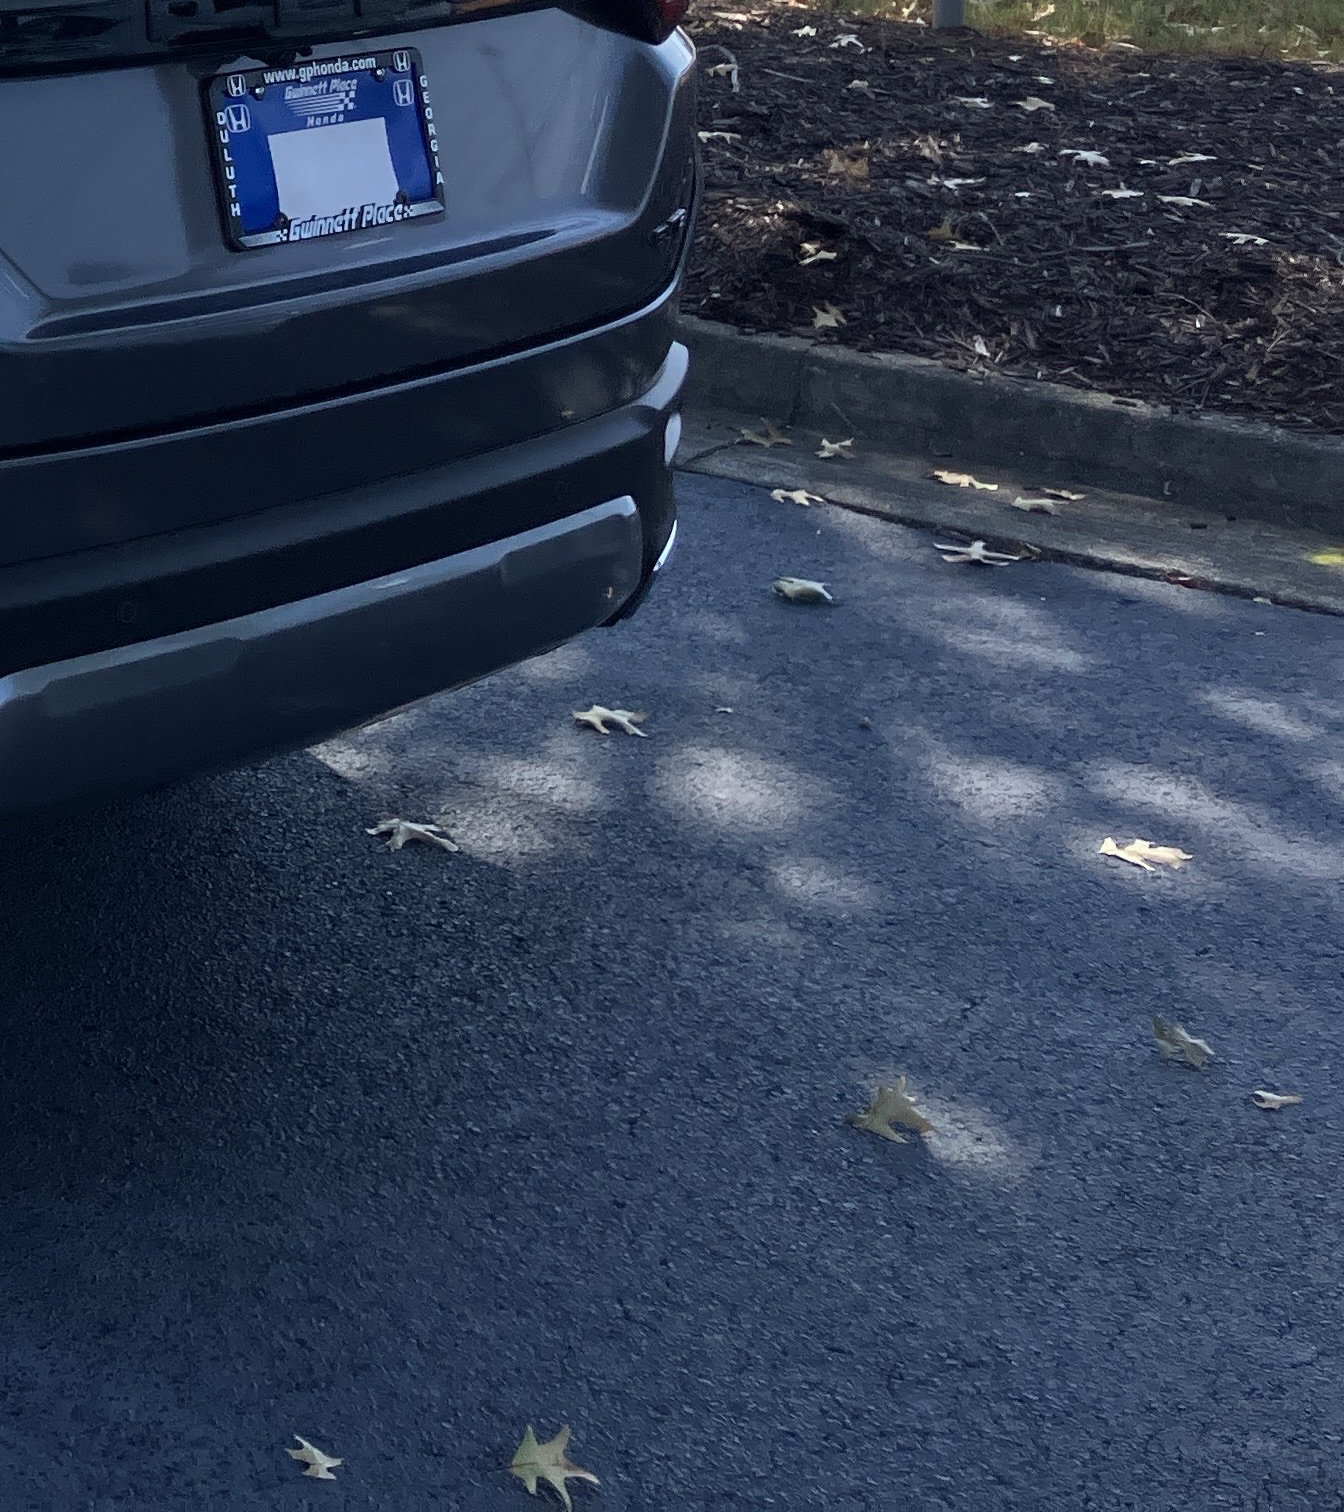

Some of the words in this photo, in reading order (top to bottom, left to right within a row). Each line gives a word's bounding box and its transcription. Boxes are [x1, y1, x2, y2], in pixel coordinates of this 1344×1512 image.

[264, 56, 376, 82] www.gphonda.com
[285, 81, 328, 100] Gwinnett
[329, 77, 358, 94] Place
[306, 113, 345, 128] Honda
[419, 75, 445, 185] GEORGIA
[216, 111, 242, 218] DULUTH
[289, 207, 359, 241] Gwinnett
[362, 203, 404, 228] Place
